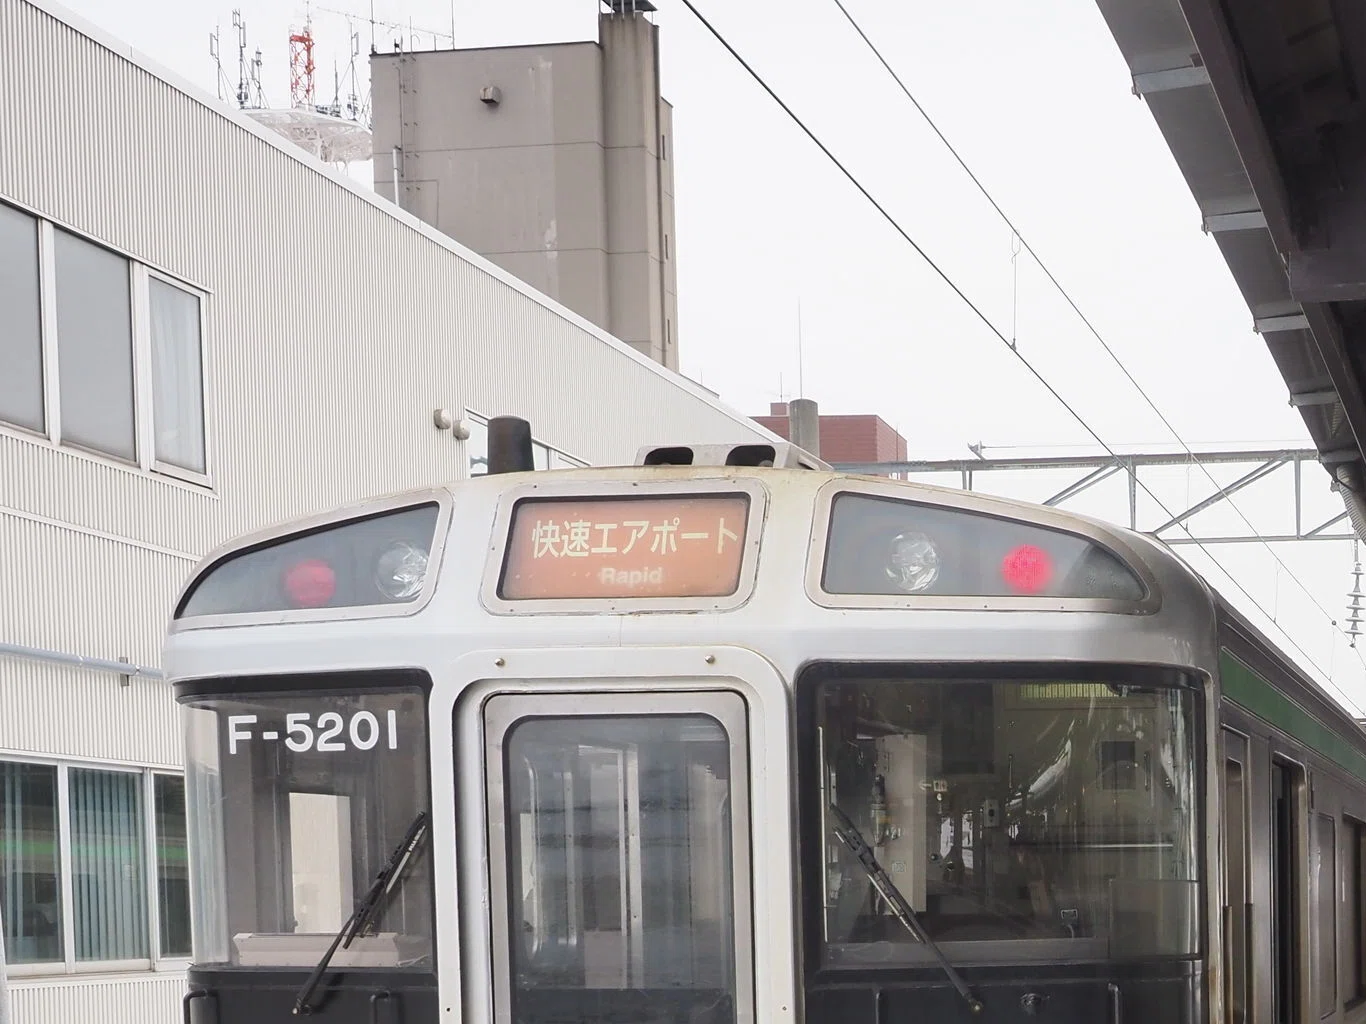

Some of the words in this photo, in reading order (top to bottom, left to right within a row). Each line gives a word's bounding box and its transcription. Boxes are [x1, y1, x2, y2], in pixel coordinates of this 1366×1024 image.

[531, 516, 738, 559] 快速エアポート
[600, 566, 664, 587] Rapid
[227, 709, 398, 755] F-5201
